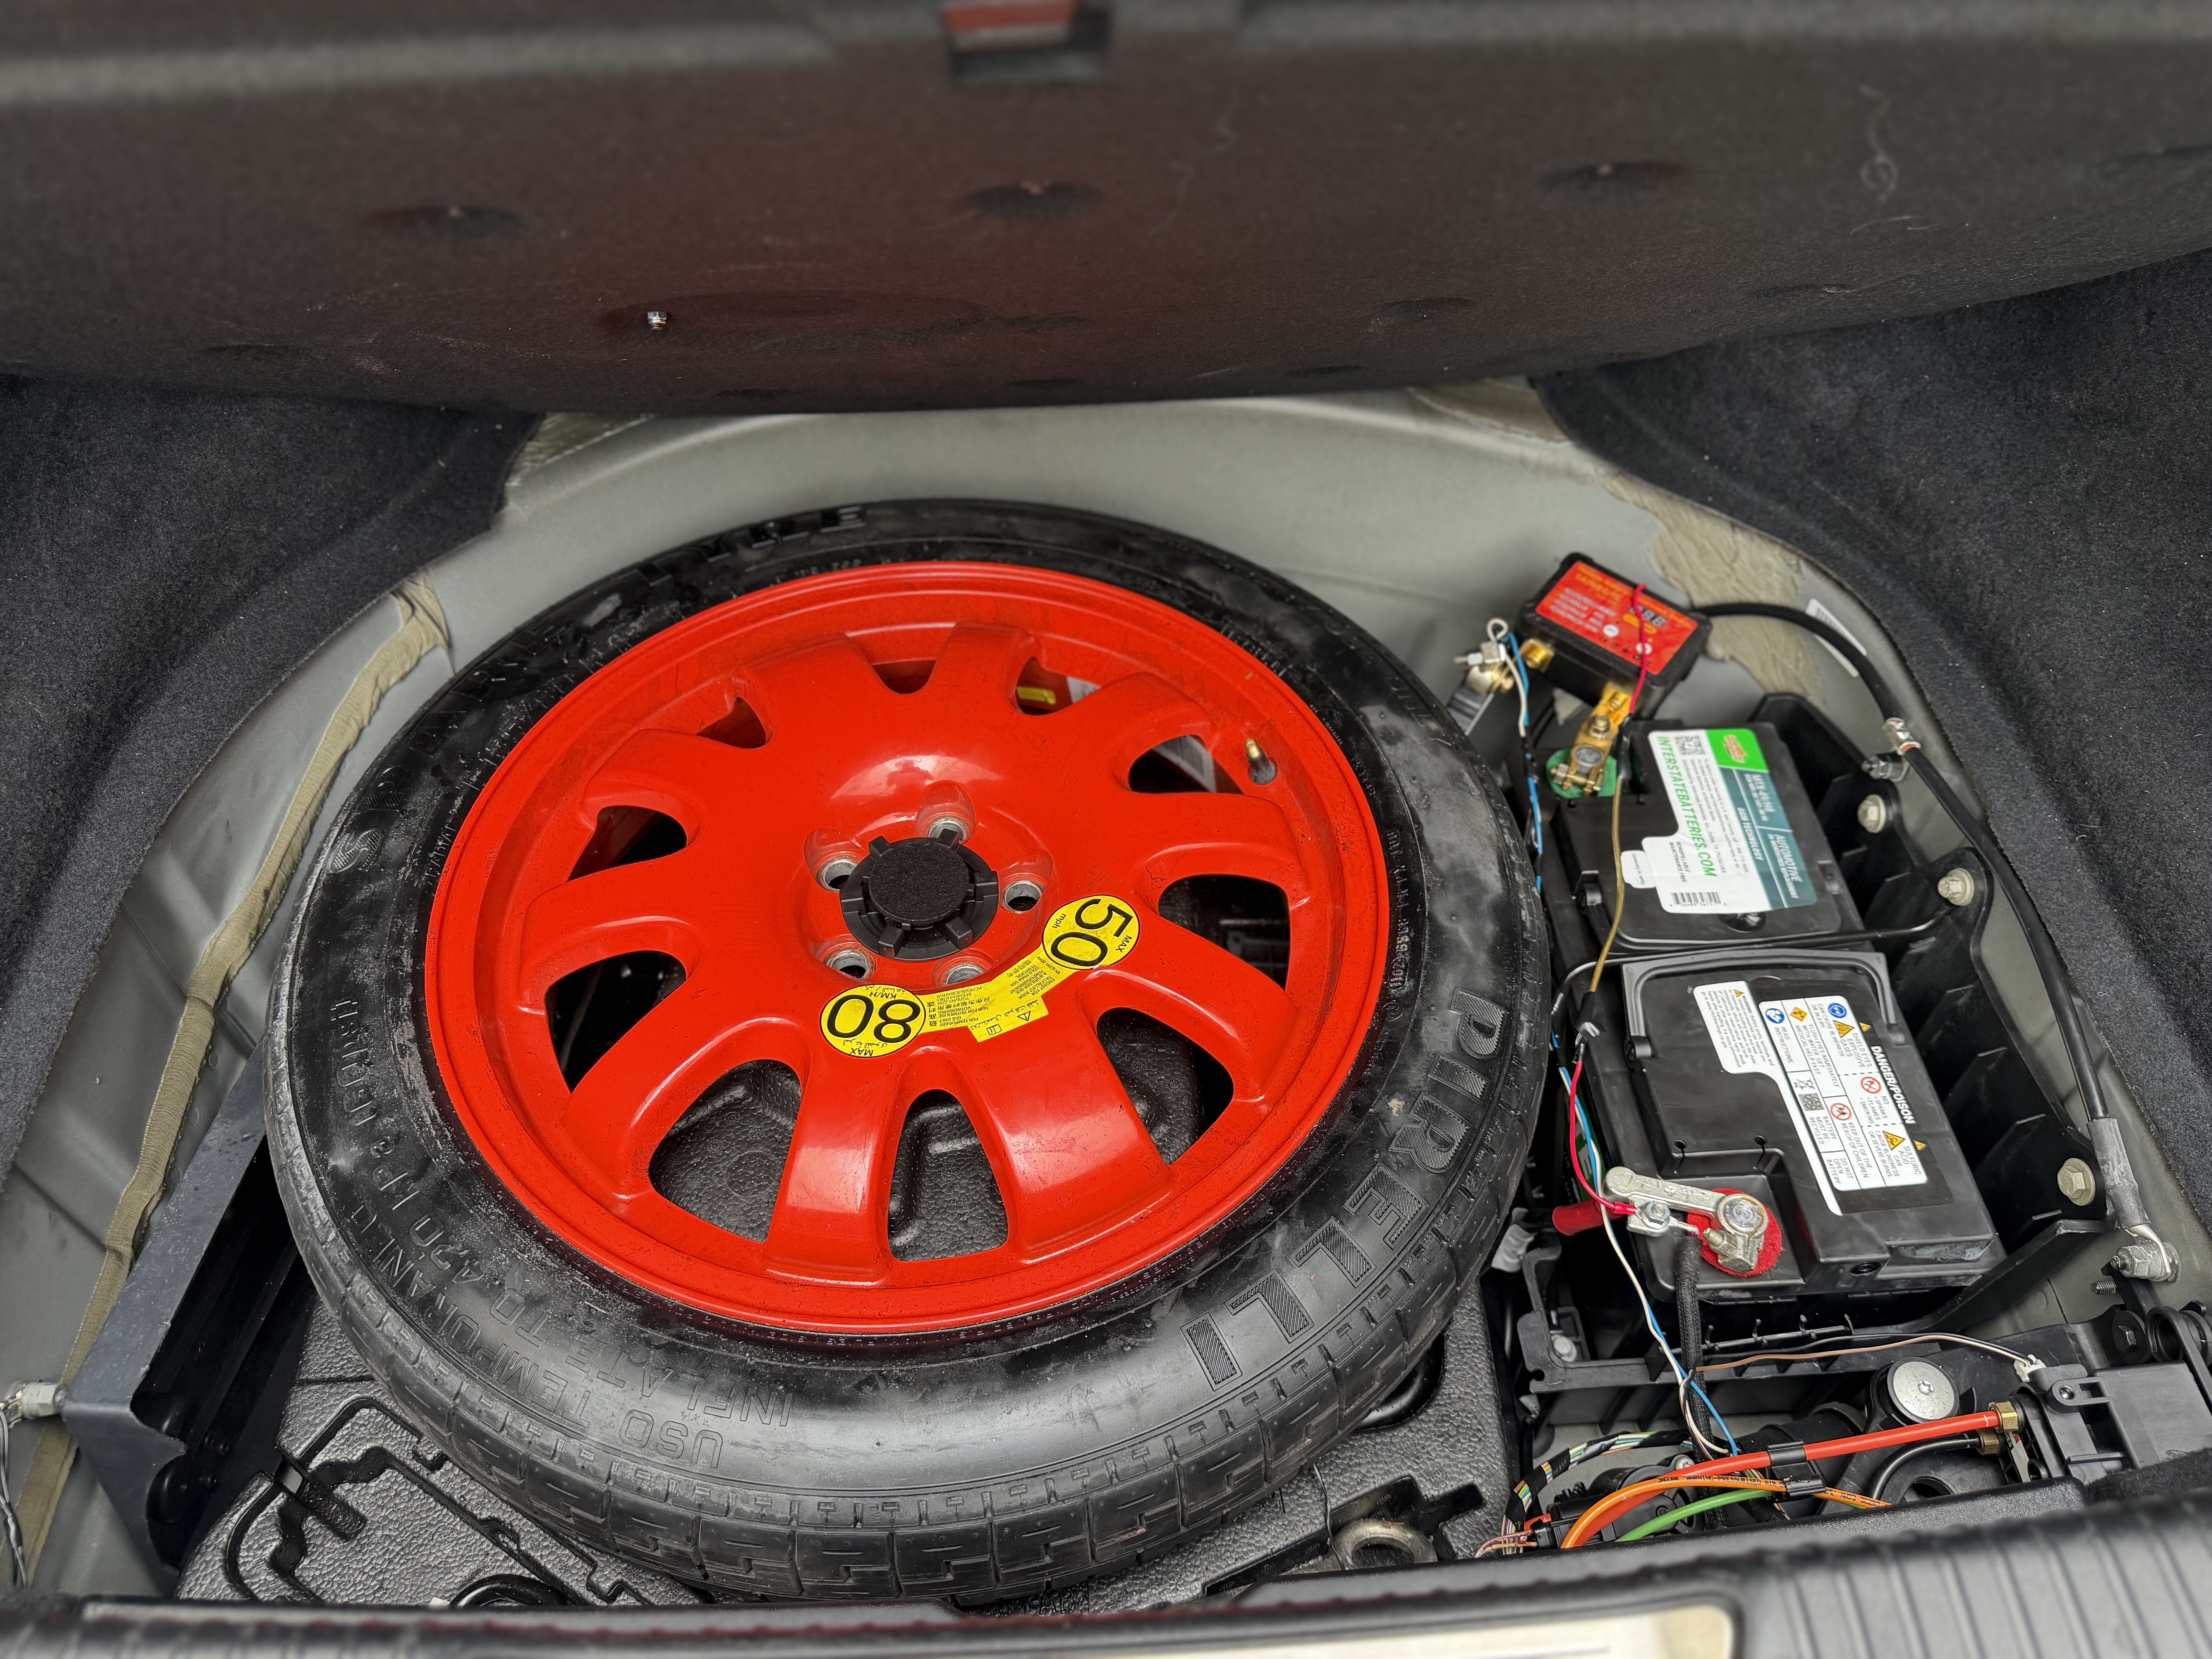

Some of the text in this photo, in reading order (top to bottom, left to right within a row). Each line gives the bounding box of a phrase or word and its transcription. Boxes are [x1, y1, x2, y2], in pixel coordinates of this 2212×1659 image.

[1654, 736, 1719, 877] INTERSTATEBATTERIES.COM
[1736, 807, 1763, 860] AGM TECHNOLOGY
[1668, 842, 1686, 883] MAINTENANCE FREE
[1774, 834, 1802, 882] AUTOMOTIVE
[1051, 913, 1066, 929] mph
[1051, 898, 1134, 966] 50
[1115, 936, 1132, 953] MAX
[1009, 969, 1044, 994] TEMPORAIREMENT
[1015, 964, 1036, 979] TEMPORAL
[1018, 973, 1029, 982] PARA
[869, 991, 896, 1000] KM/H
[937, 986, 982, 998] ИСПОЛЬЗОВАНИЯ
[1017, 991, 1029, 1000] BRUK
[827, 994, 921, 1043] 80
[927, 1001, 938, 1027] 最高时速
[970, 1014, 1002, 1031] للاستعمال
[1026, 999, 1039, 1008] فقط
[1780, 1027, 1790, 1039] READ
[1795, 1025, 1808, 1047] MEDICAL
[1804, 1048, 1814, 1061] HELP
[1817, 1004, 1845, 1056] CAN CAUSE BLINDNESS
[1851, 1032, 1866, 1052] SHIELD
[849, 1047, 874, 1056] MAX
[1801, 1025, 1824, 1068] WITH WATER. GET
[1807, 1024, 1840, 1087] FLUSH EYES IMMEDIATELY
[1839, 1039, 1853, 1057] GASES
[1847, 1038, 1865, 1068] EXPLOSIVE
[1870, 1046, 1916, 1124] DANGER/POISON
[1859, 1101, 1874, 1124] SMOKING
[1867, 1100, 1880, 1120] FLAMES
[1874, 1100, 1887, 1118] SPARKS
[1880, 1096, 1889, 1104] NO
[1815, 1117, 1826, 1132] MUST
[1822, 1116, 1837, 1139] BATTERY
[1840, 1123, 1853, 1141] REACH
[1852, 1151, 1869, 1179] CHILDREN.
[1847, 1122, 1857, 1135] KEEP
[1853, 1137, 1863, 1147] OUT
[1862, 1158, 1872, 1168] THE
[1871, 1139, 1884, 1158] SEVERE
[1880, 1159, 1893, 1178] BURNS.
[1875, 1131, 1899, 1176] CAUSE BLINDNESS
[1898, 1150, 1910, 1164] ACID
[1832, 1159, 1844, 1173] OPEN
[1844, 1167, 1853, 1178] NOT
[1893, 1155, 1902, 1166] CAN
[1903, 1146, 1921, 1175] SULFURIC
[1179, 991, 1508, 1393] PIRELLI
[407, 1206, 485, 1300] 420
[489, 1286, 543, 1350] TO
[560, 1330, 794, 1429] INFLATE
[615, 1404, 724, 1471] USO
